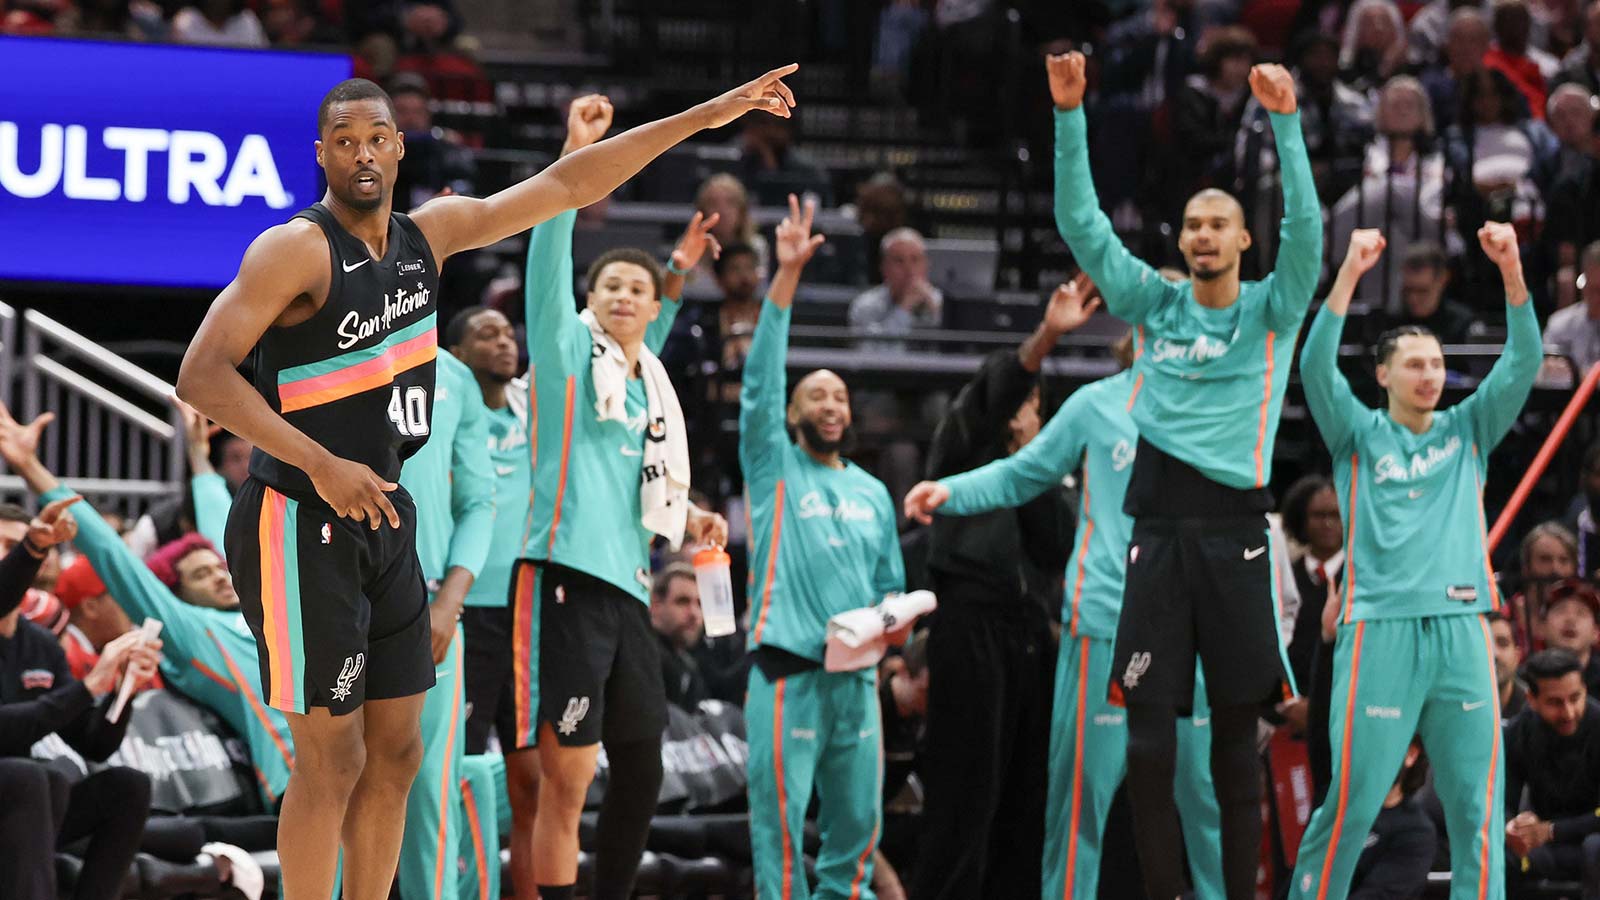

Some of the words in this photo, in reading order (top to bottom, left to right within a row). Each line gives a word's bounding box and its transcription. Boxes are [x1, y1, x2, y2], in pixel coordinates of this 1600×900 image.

[0, 121, 289, 210] ULTRA
[401, 263, 421, 272] LEDGER
[337, 311, 380, 350] San
[381, 281, 430, 330] Antonio
[387, 386, 430, 437] 40
[1374, 454, 1408, 484] San
